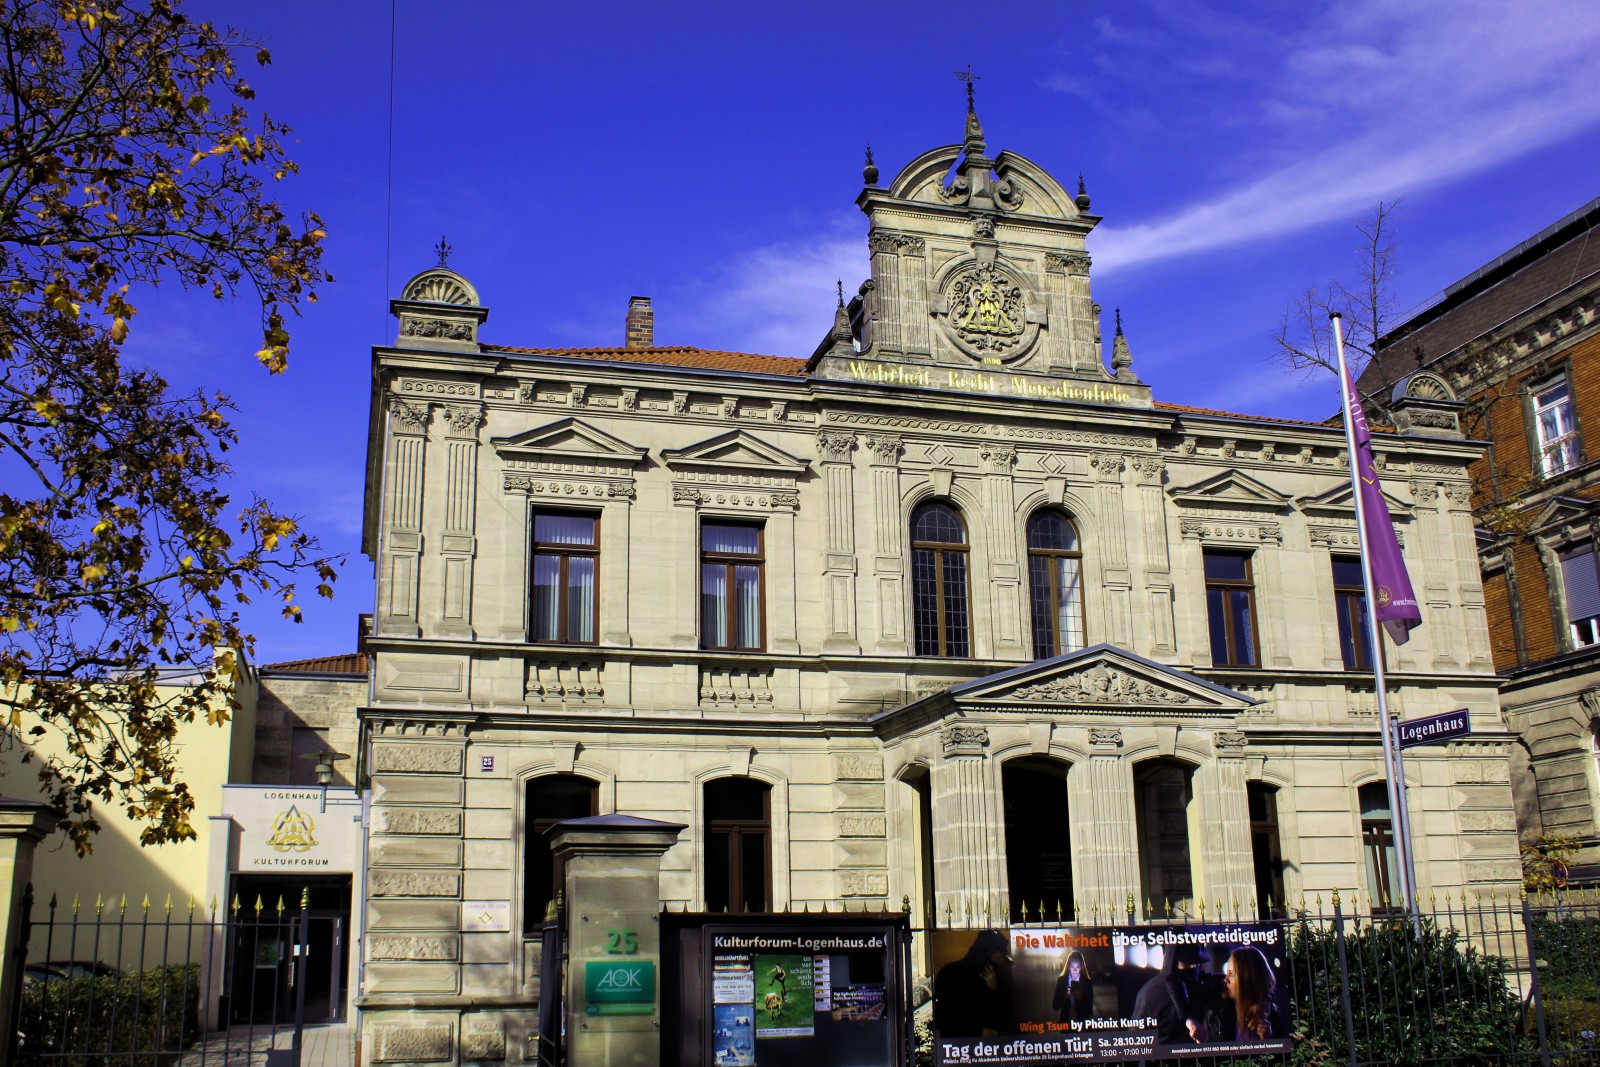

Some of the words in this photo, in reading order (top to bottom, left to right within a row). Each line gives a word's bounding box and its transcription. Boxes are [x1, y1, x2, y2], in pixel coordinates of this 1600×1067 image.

[984, 357, 1002, 365] 1890
[849, 361, 930, 385] Wahrheit
[947, 370, 995, 391] Recht
[1011, 376, 1130, 401] Menschenliebe
[1401, 717, 1464, 740] Logenhaus
[483, 758, 492, 766] 25
[605, 928, 638, 953] 25
[714, 936, 882, 950] Kulturforum-Logenhaus.de
[1016, 934, 1039, 949] Die
[1043, 932, 1109, 948] Wahrheit
[1112, 930, 1145, 946] über
[1147, 928, 1278, 945] Selbstverteidigung!
[598, 968, 641, 987] AOK
[1020, 1021, 1045, 1033] Wing
[1046, 1021, 1069, 1031] Tsun
[1070, 1019, 1083, 1032] by
[1085, 1017, 1118, 1029] Phönix
[1120, 1017, 1145, 1029] Kung
[1147, 1017, 1157, 1026] Fu
[943, 1043, 970, 1060] Tag
[974, 1042, 1000, 1057] der
[1003, 1040, 1061, 1055] offenen
[1065, 1036, 1093, 1053] Tür!
[1098, 1038, 1112, 1047] Sa.
[1113, 1036, 1155, 1046] 28.10.2017
[1100, 1048, 1117, 1056] 13:00
[1123, 1047, 1139, 1056] 17:00
[1141, 1047, 1153, 1055] Uhr
